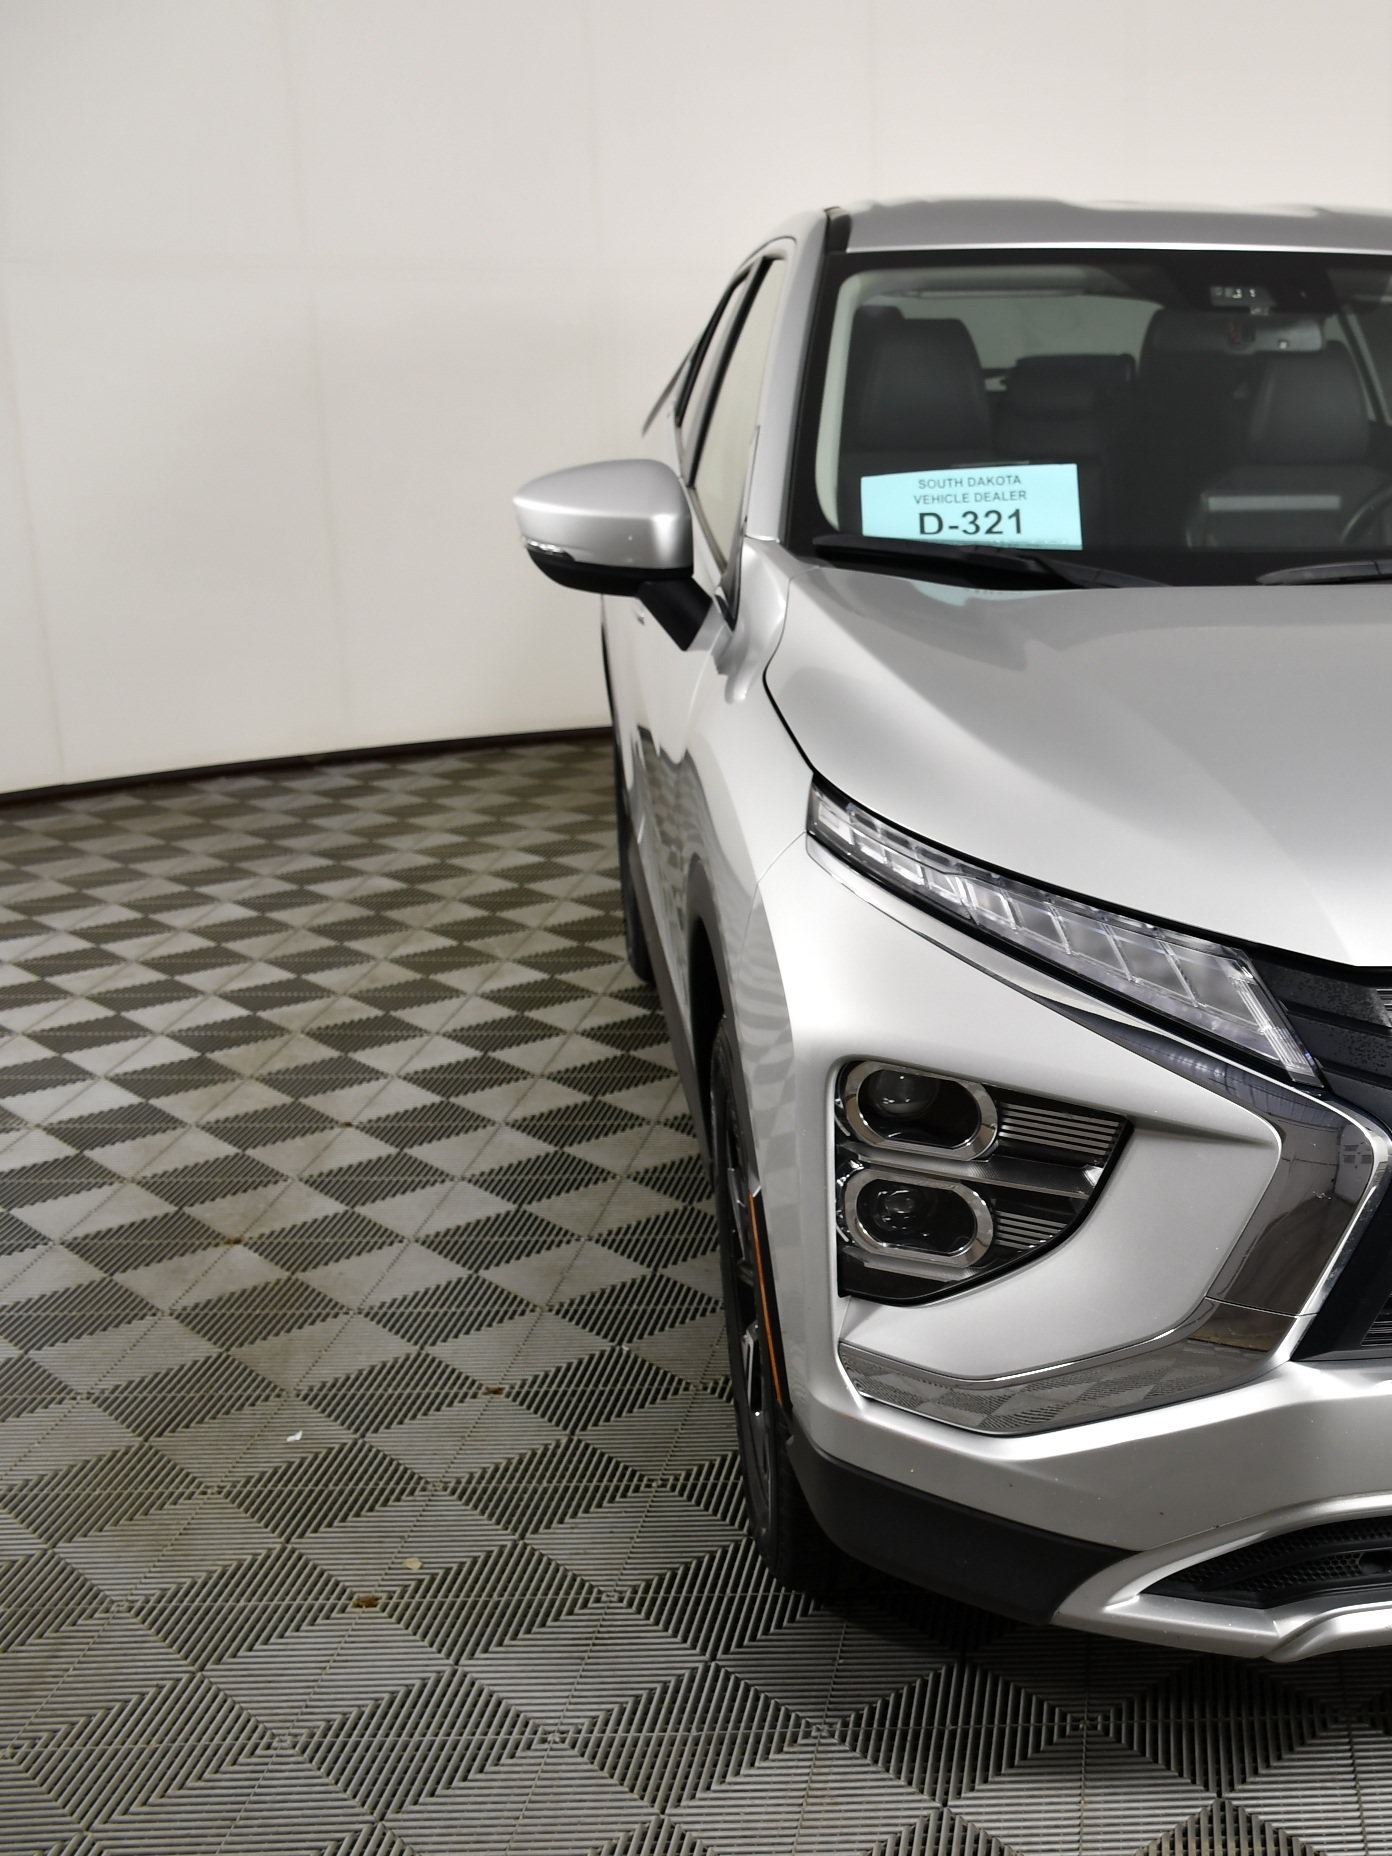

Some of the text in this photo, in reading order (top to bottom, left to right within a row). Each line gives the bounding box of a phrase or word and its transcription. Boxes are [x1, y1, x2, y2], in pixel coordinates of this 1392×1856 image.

[918, 475, 1022, 490] SOUTH DAKOTA
[914, 490, 1027, 505] VEHICLE DEALER
[919, 508, 1022, 535] D-321
